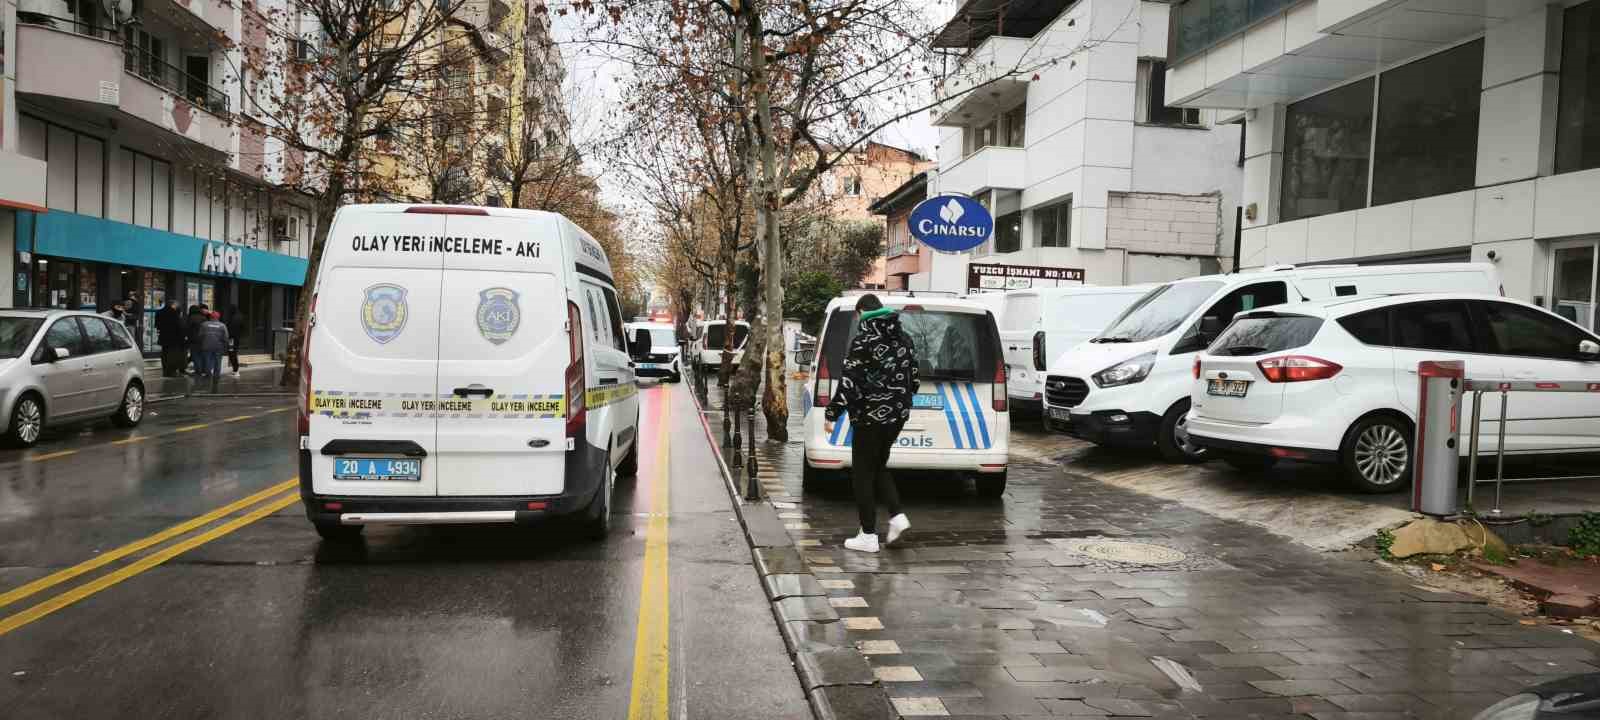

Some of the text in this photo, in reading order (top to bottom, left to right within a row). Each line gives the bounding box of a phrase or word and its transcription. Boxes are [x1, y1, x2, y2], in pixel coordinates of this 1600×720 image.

[352, 235, 389, 252] OLAY
[315, 399, 330, 408] OLAY
[401, 401, 418, 410] OLAY
[491, 402, 508, 411] OLAY
[342, 460, 417, 475] 20 A 4934
